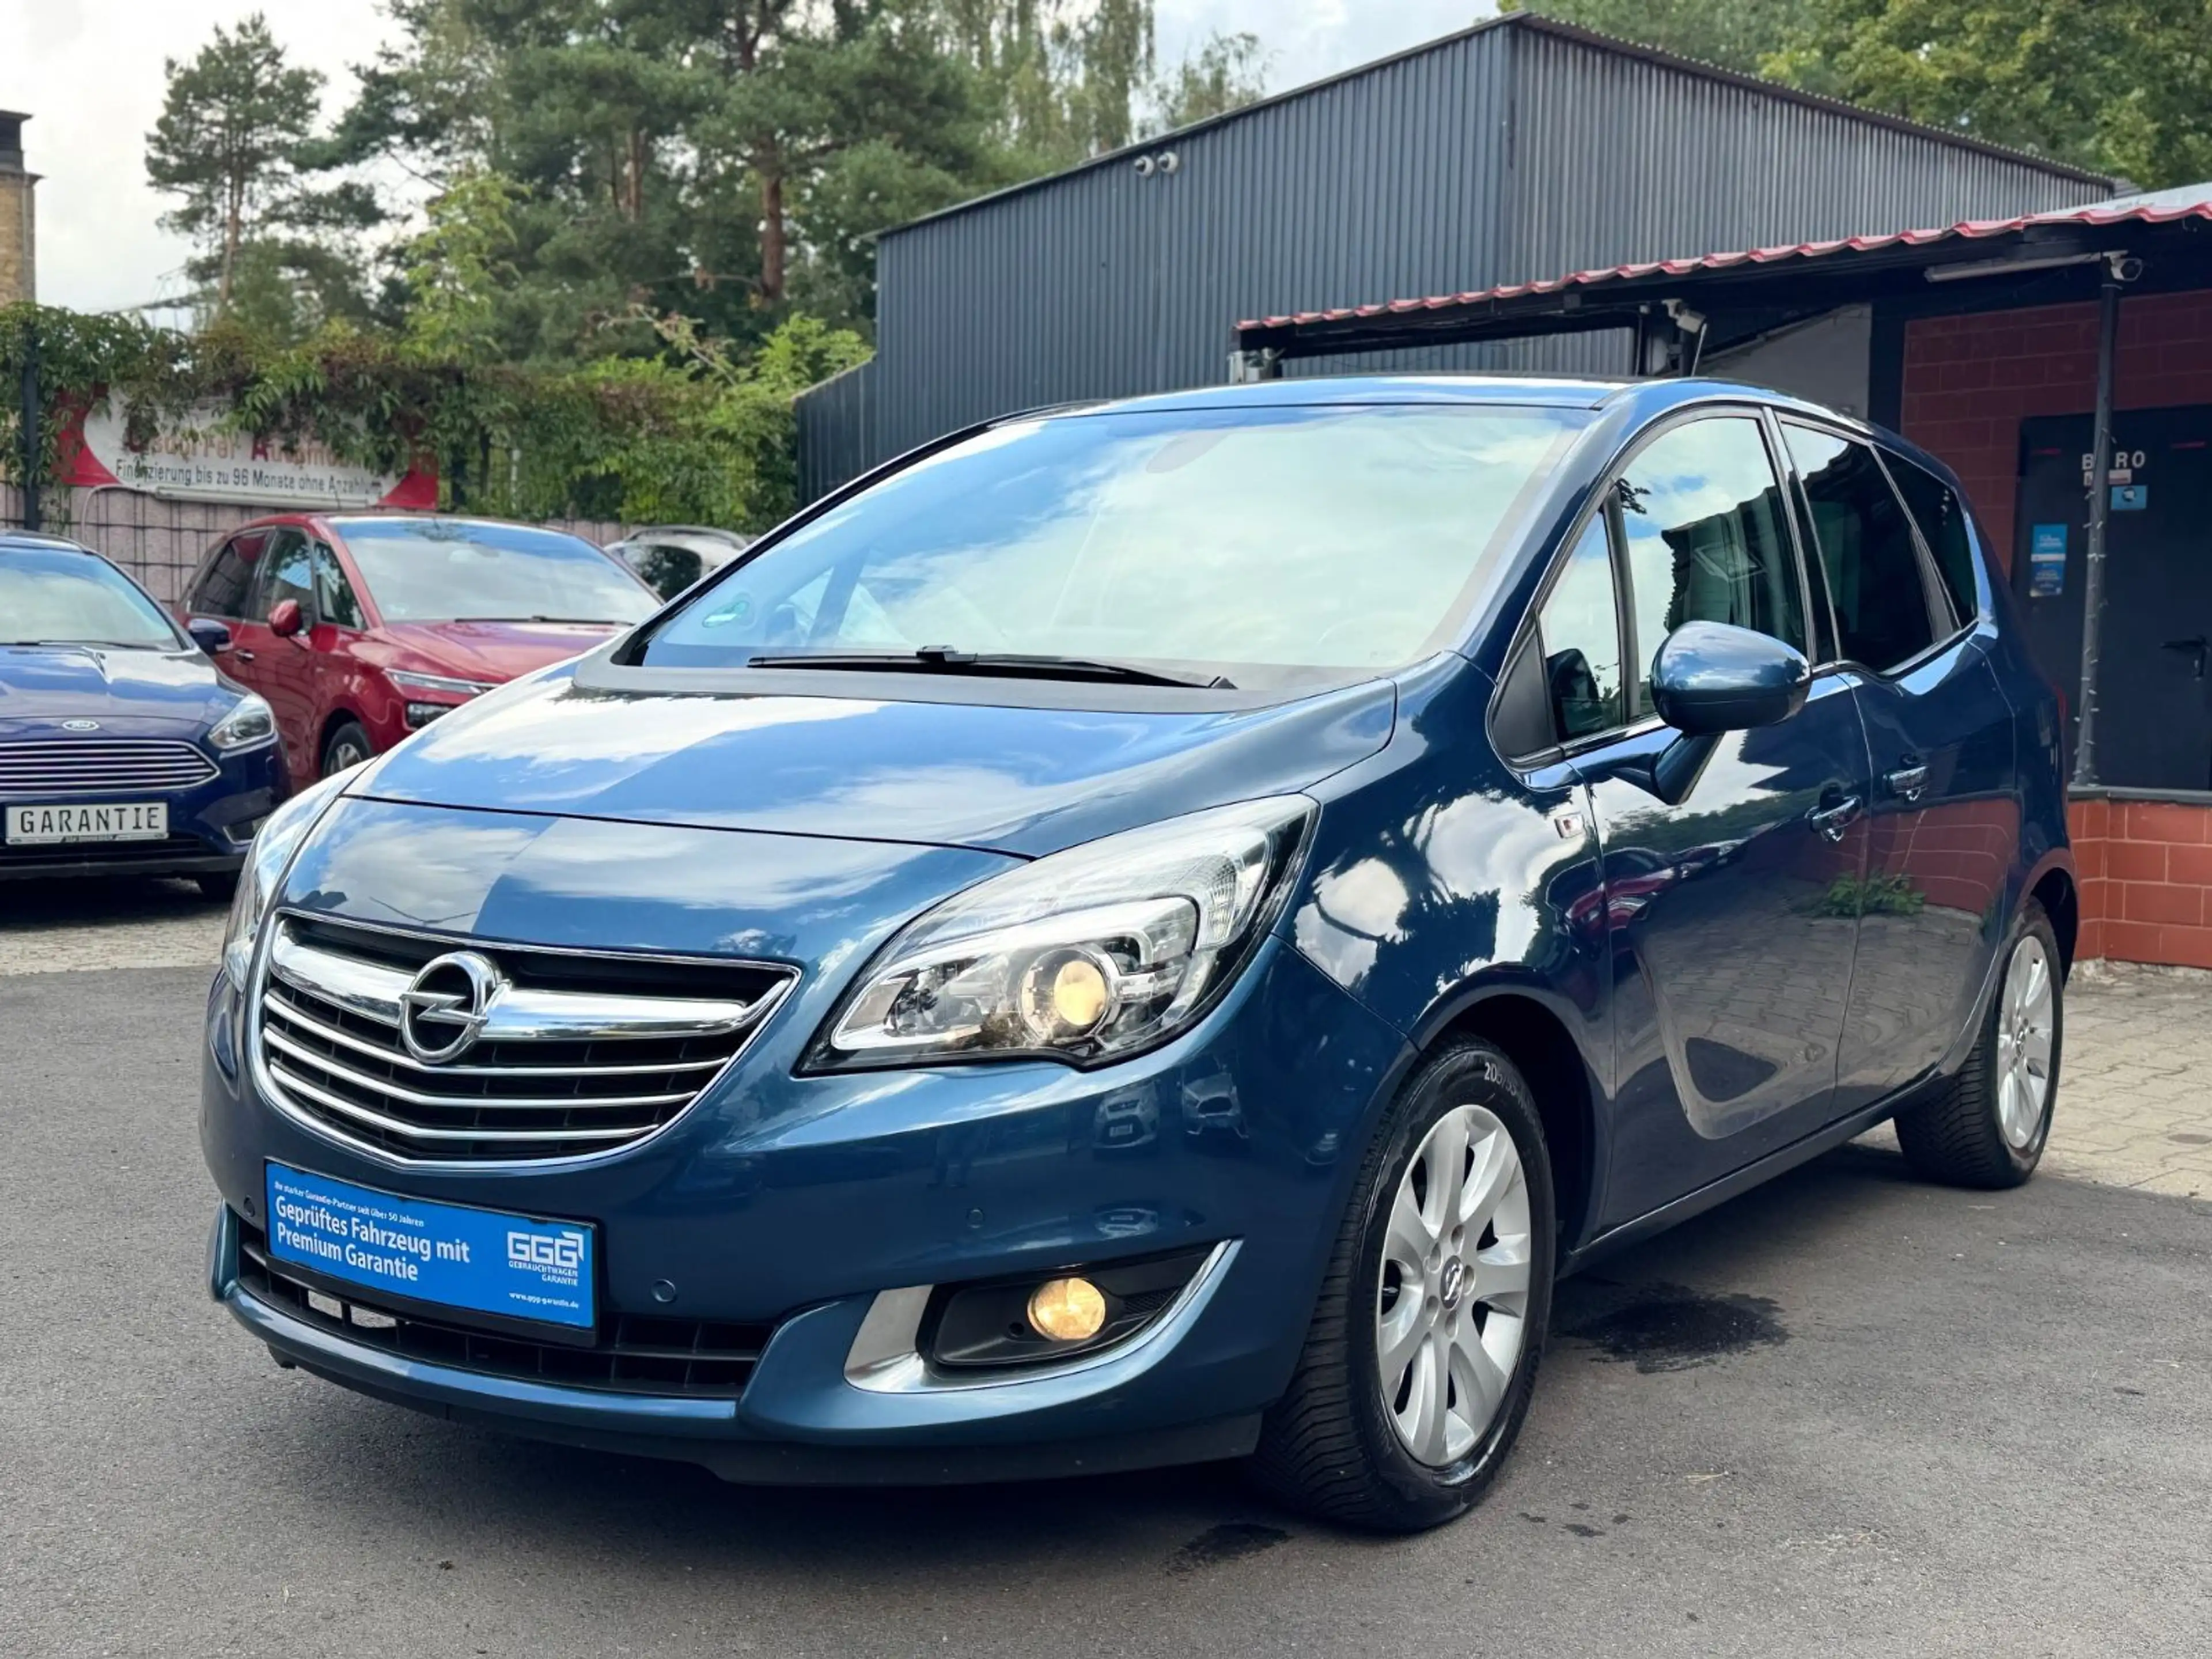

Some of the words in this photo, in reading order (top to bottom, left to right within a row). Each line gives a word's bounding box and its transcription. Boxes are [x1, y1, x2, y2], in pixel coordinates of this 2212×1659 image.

[2082, 450, 2146, 470] BRO
[196, 465, 212, 483] bis
[217, 469, 229, 485] zu
[233, 467, 249, 486] 96
[253, 469, 294, 490] Monate
[299, 474, 324, 491] ohne
[21, 807, 160, 833] GARANTIE
[275, 1195, 348, 1237] Geprüftes
[351, 1217, 431, 1262] Fahrzeug
[436, 1238, 470, 1263] mit
[388, 1212, 397, 1222] 50
[277, 1222, 342, 1262] Premium
[346, 1243, 418, 1282] Garantie
[507, 1231, 579, 1268] GGG
[509, 1260, 578, 1277] GEBRAUCHTWAGEN
[541, 1273, 578, 1286] GARANTIE
